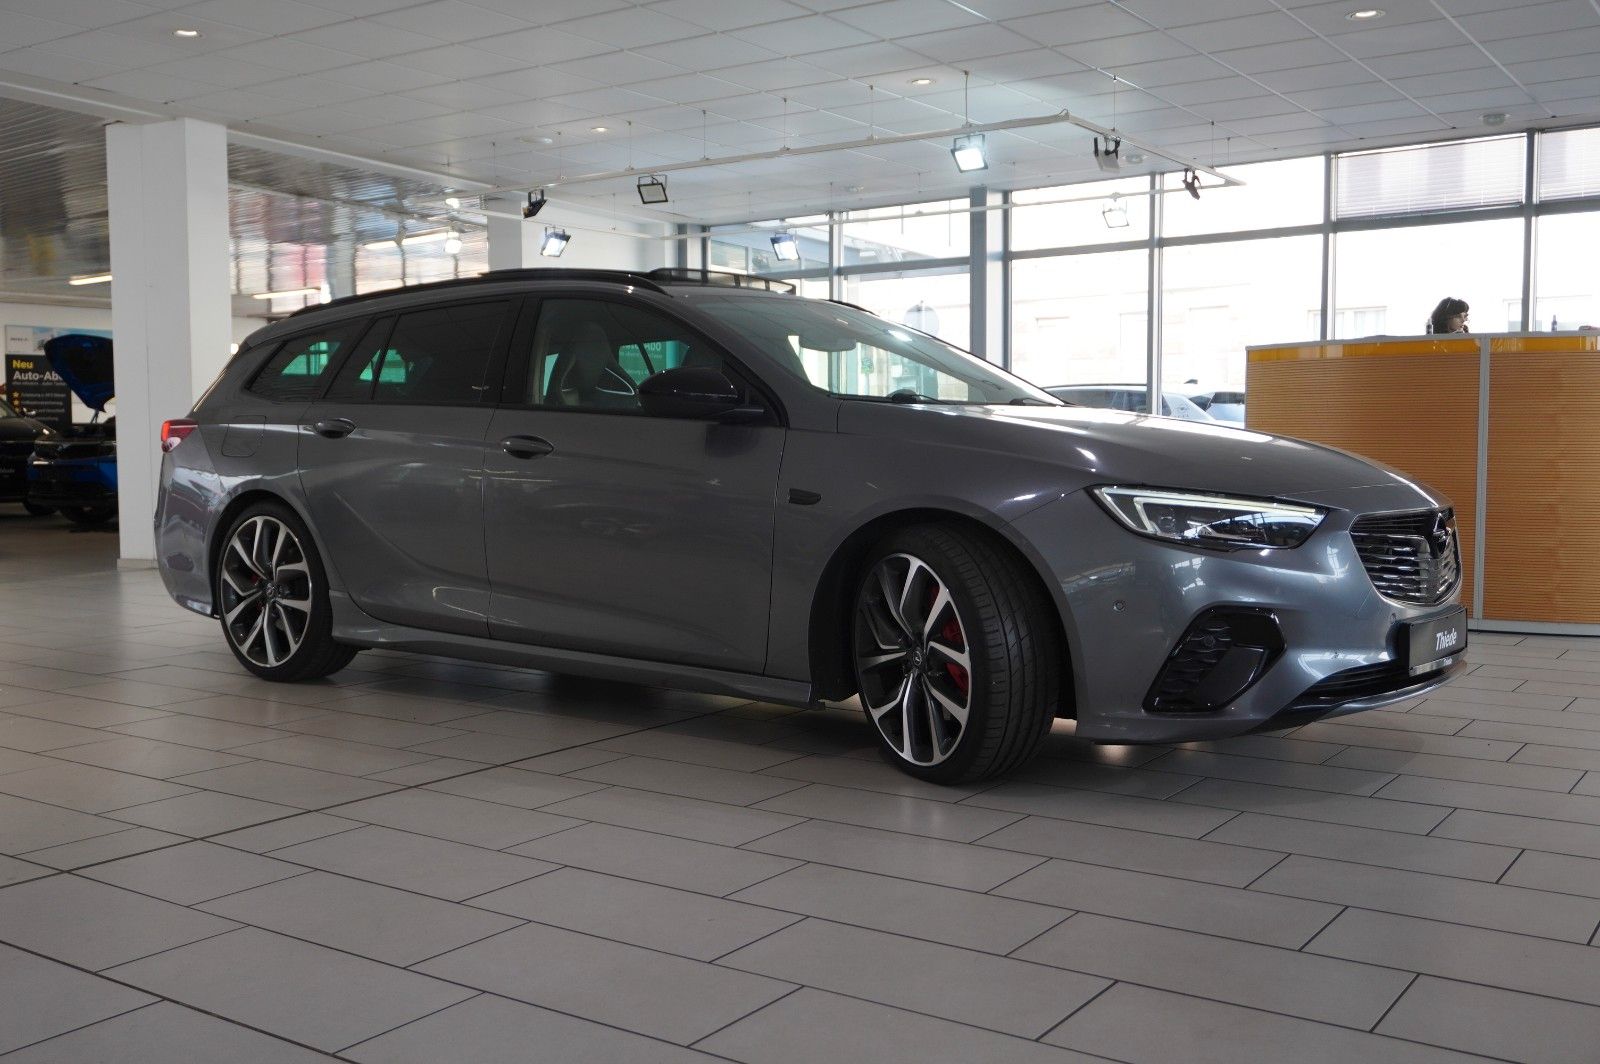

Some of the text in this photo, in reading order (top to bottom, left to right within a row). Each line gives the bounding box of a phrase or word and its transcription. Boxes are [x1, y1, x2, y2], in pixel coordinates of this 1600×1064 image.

[12, 360, 33, 369] Neu
[13, 371, 63, 380] Auto-Ab
[1436, 628, 1457, 651] Thiede
